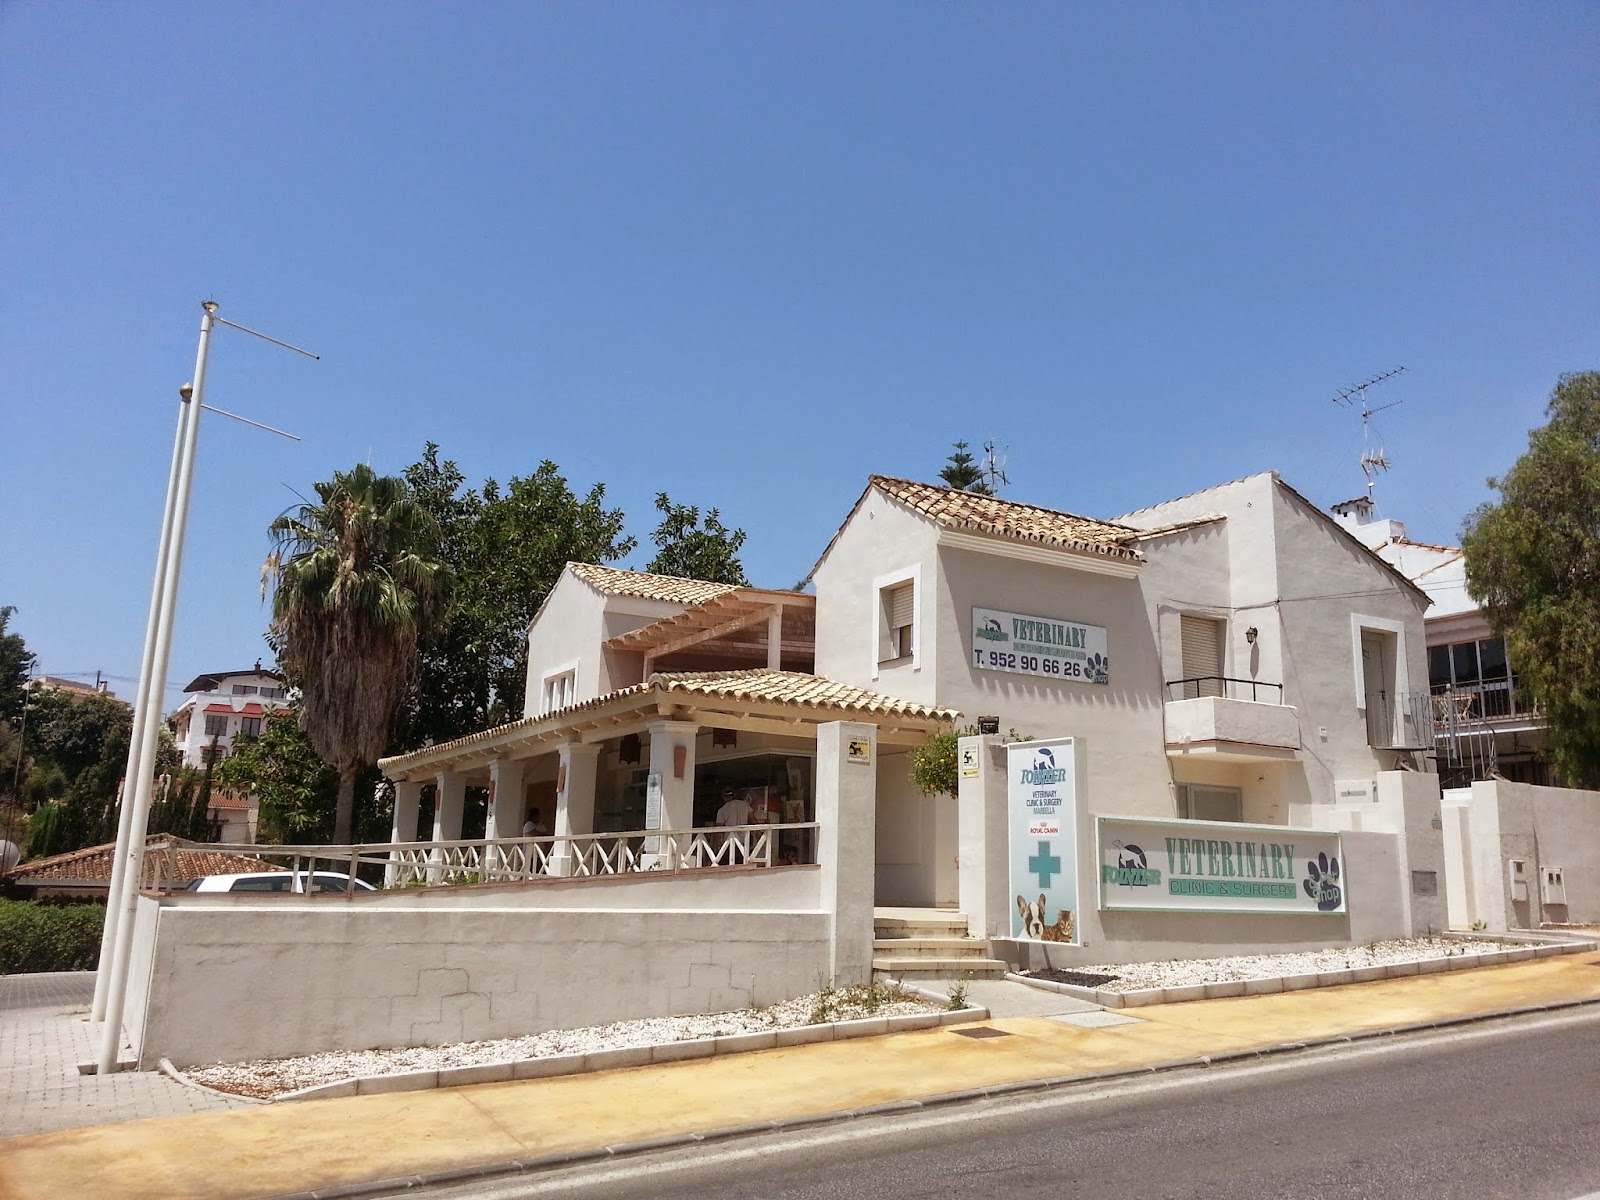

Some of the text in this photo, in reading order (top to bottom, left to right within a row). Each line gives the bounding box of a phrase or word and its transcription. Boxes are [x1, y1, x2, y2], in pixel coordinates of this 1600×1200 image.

[1012, 618, 1087, 649] VETERINARY
[975, 649, 985, 665] T.
[990, 651, 1016, 668] 952
[1021, 655, 1038, 671] 90
[1043, 658, 1060, 674] 66
[1064, 661, 1081, 677] 26
[1026, 799, 1038, 807] CLINIC
[1043, 798, 1062, 807] SURGERY
[1032, 790, 1057, 799] VETERINARY
[1033, 807, 1056, 815] MARBELLA
[1164, 837, 1295, 880] VETERINARY
[1170, 880, 1296, 897] CLINIC & SURGERY
